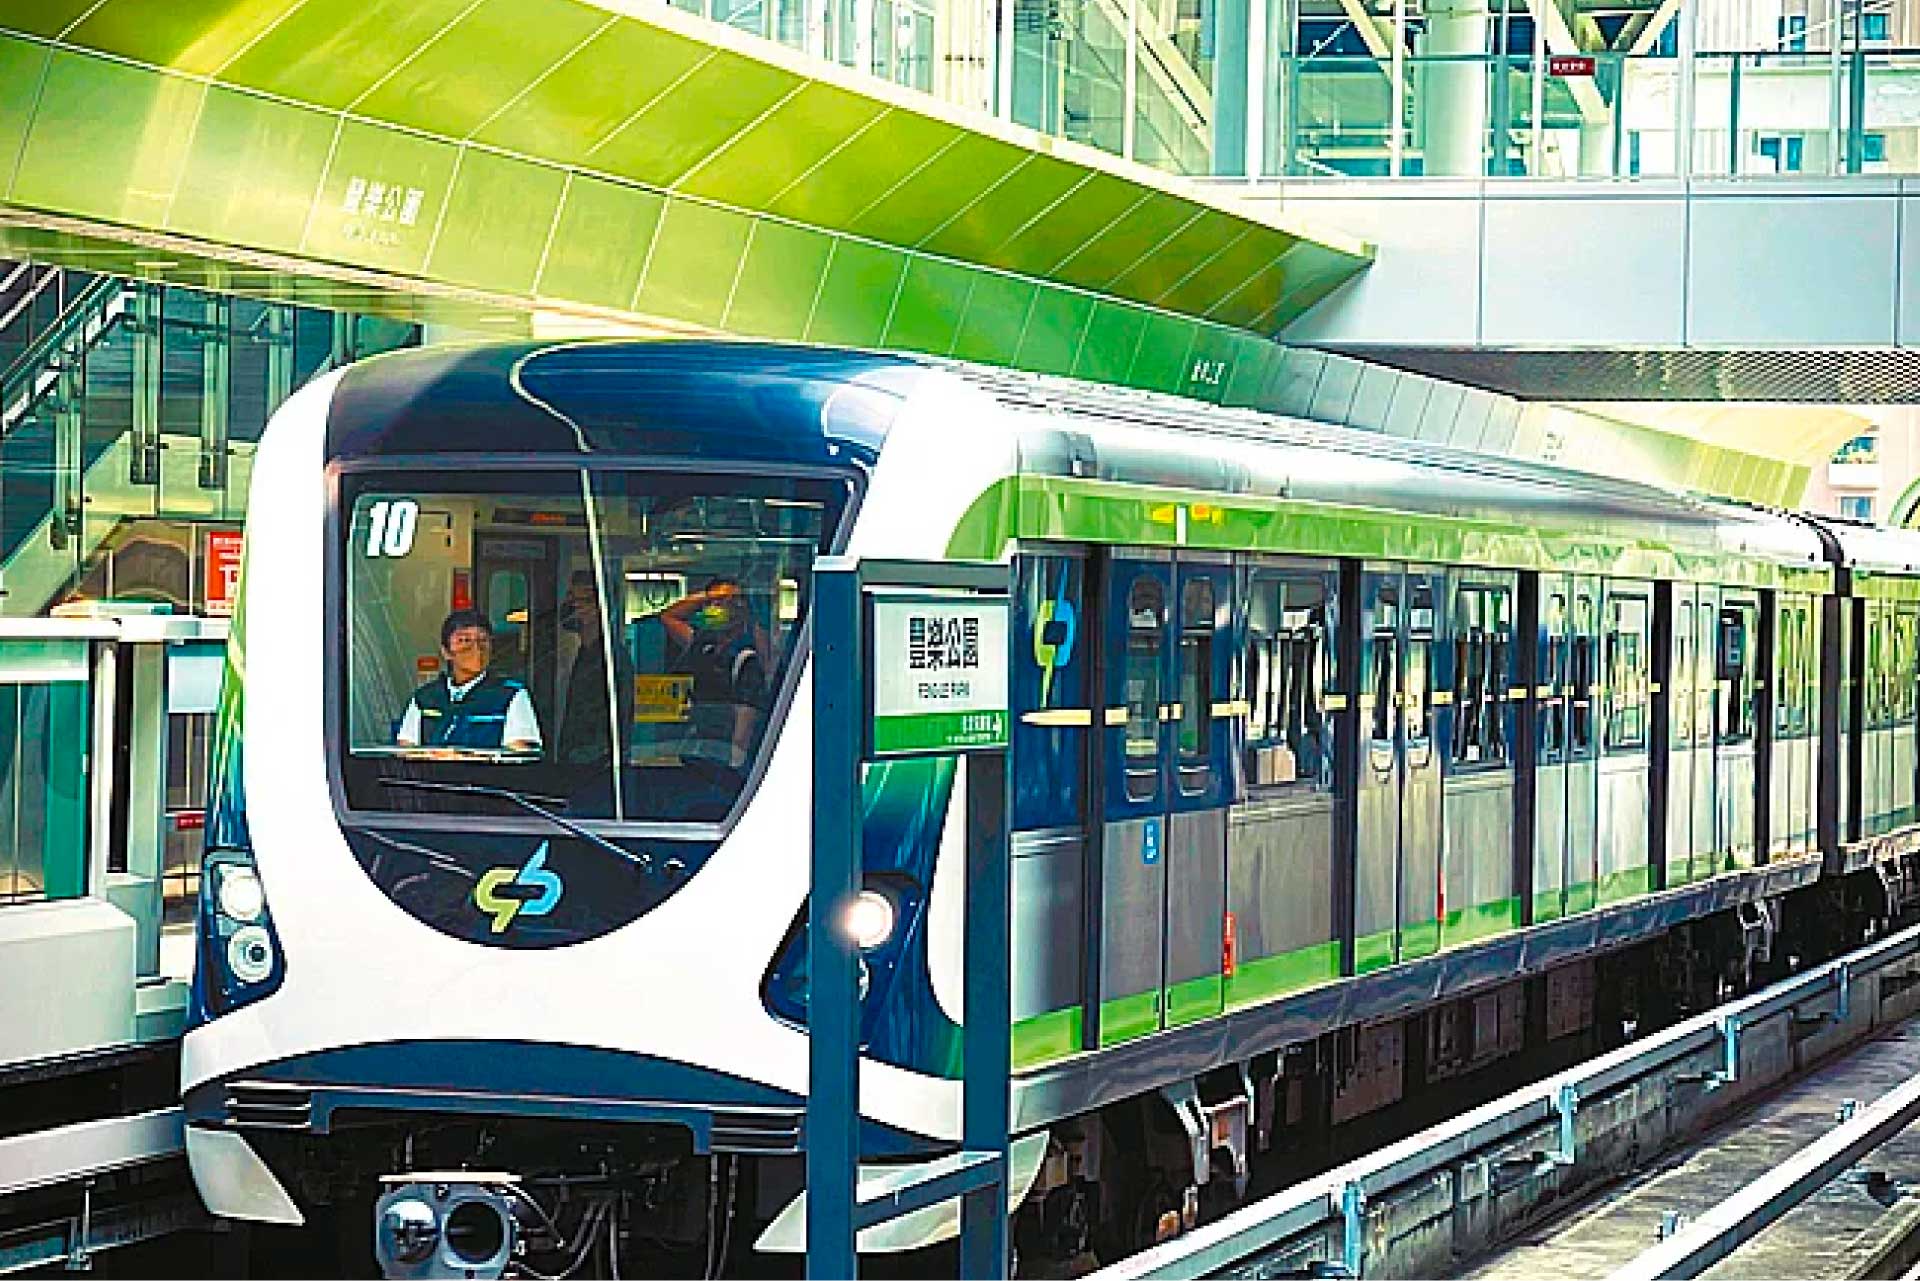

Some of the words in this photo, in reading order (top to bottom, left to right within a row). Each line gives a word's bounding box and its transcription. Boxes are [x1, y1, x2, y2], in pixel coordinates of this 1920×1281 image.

[367, 502, 418, 557] 10
[909, 617, 979, 671] 豐樂公園
